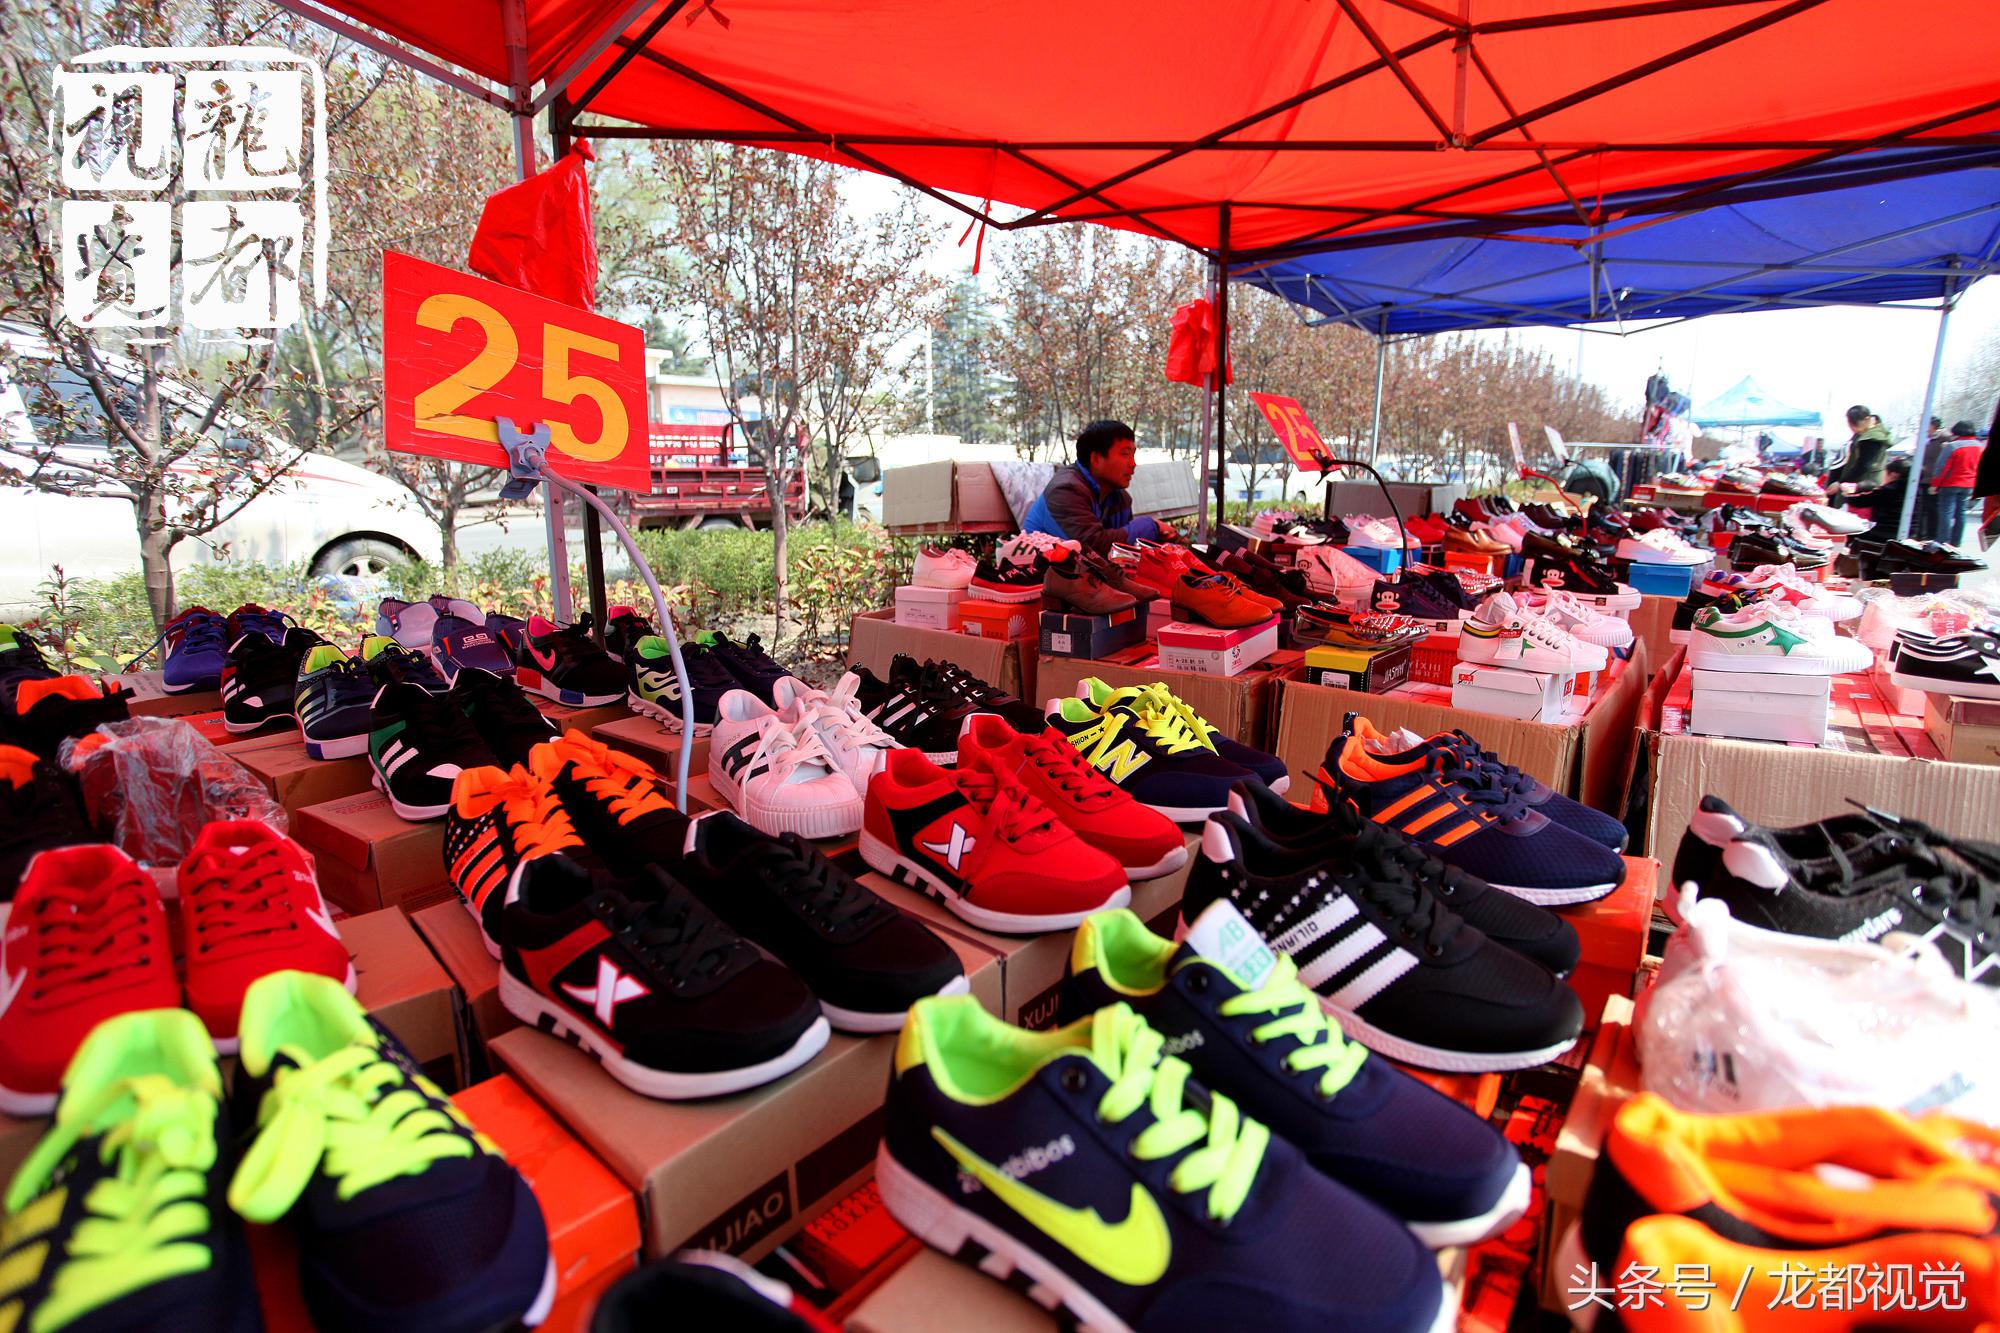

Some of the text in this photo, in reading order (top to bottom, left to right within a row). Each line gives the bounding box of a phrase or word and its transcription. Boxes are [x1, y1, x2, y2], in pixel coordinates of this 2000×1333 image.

[414, 293, 630, 463] 25
[1266, 402, 1328, 461] 25
[1096, 738, 1152, 784] N
